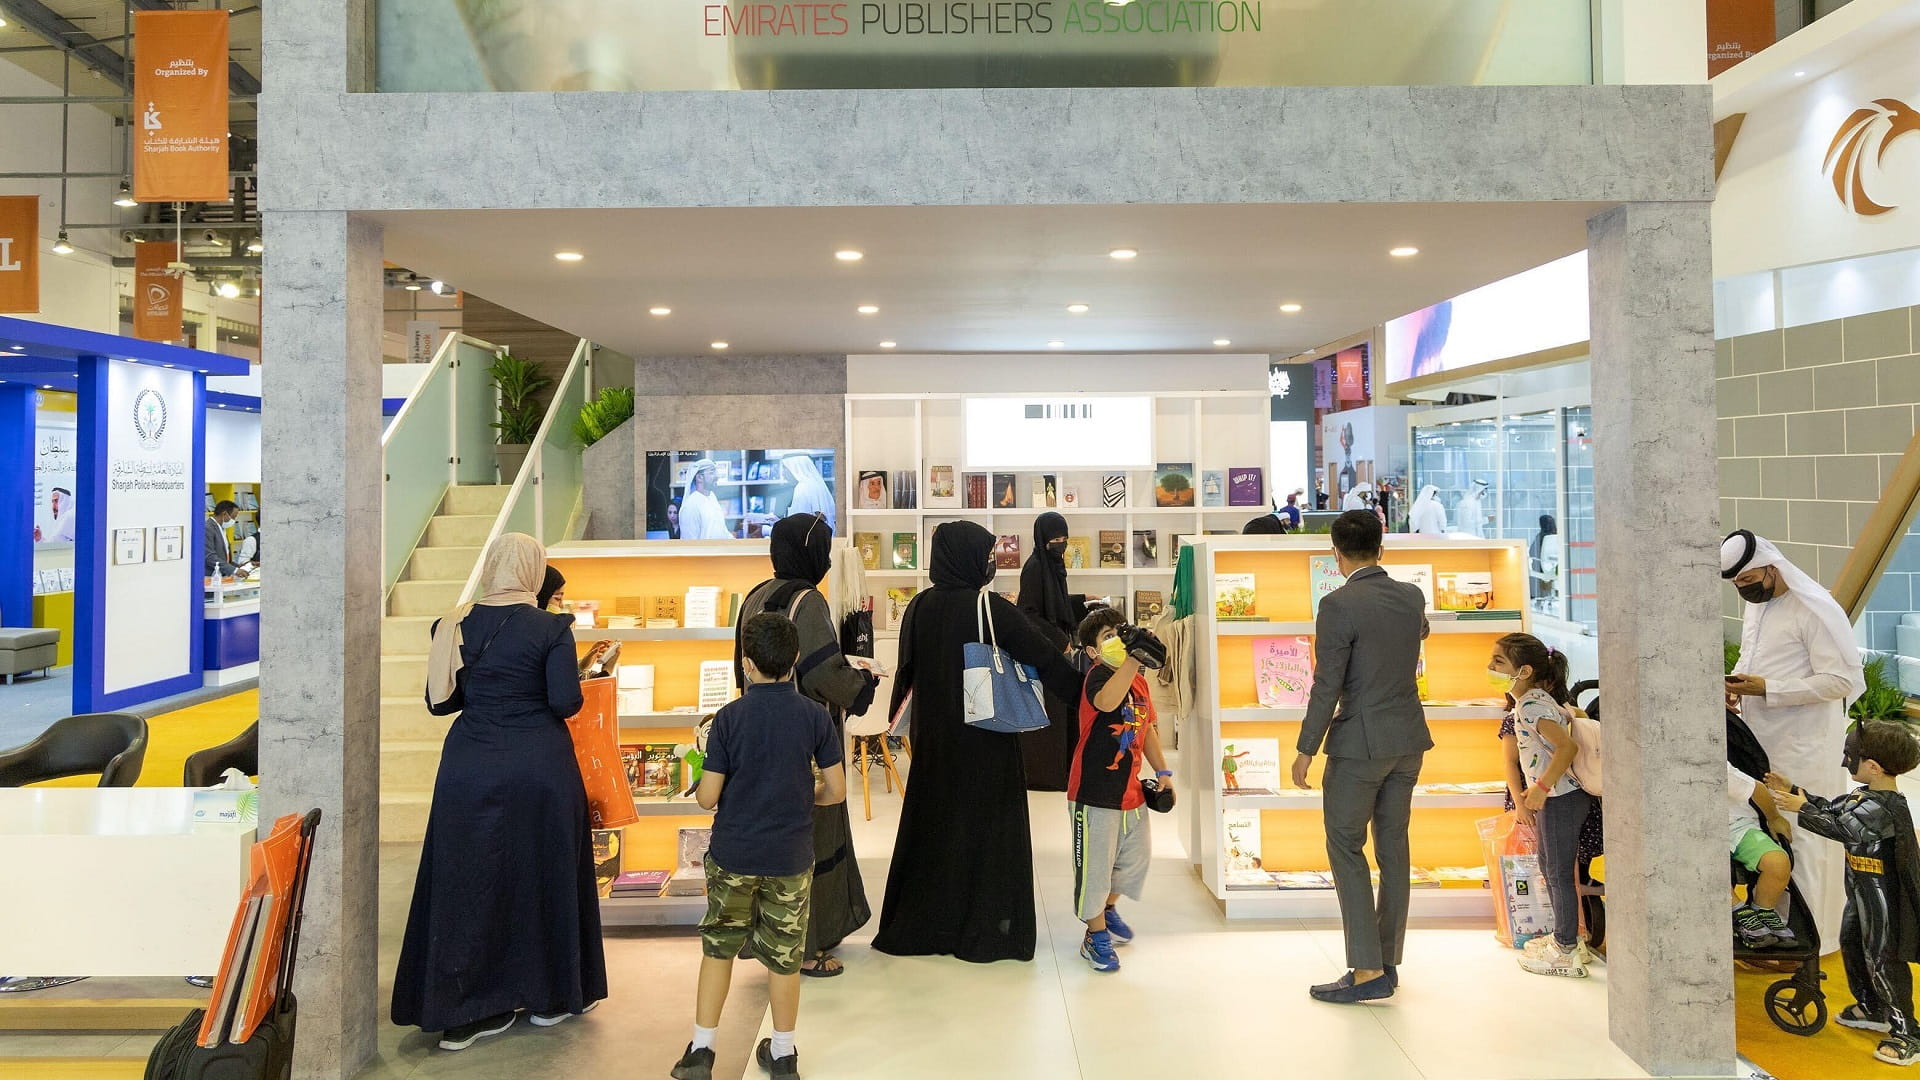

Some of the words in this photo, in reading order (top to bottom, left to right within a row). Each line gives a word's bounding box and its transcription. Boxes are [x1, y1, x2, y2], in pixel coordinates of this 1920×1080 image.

[703, 3, 849, 37] EMIRATES
[861, 1, 1053, 36] PUBLISHERS
[1063, 0, 1262, 34] ASSOCIATION
[1708, 51, 1742, 60] rganized
[170, 58, 194, 68] بتنظيم
[155, 68, 196, 77] Organized
[198, 69, 208, 77] By
[143, 145, 169, 153] Sharjah
[187, 145, 220, 153] Authority
[111, 479, 133, 493] Sharjah
[134, 478, 151, 491] Police
[151, 478, 185, 492] Headquarters
[1270, 642, 1298, 657] الأميرة
[621, 750, 642, 761] البؤس
